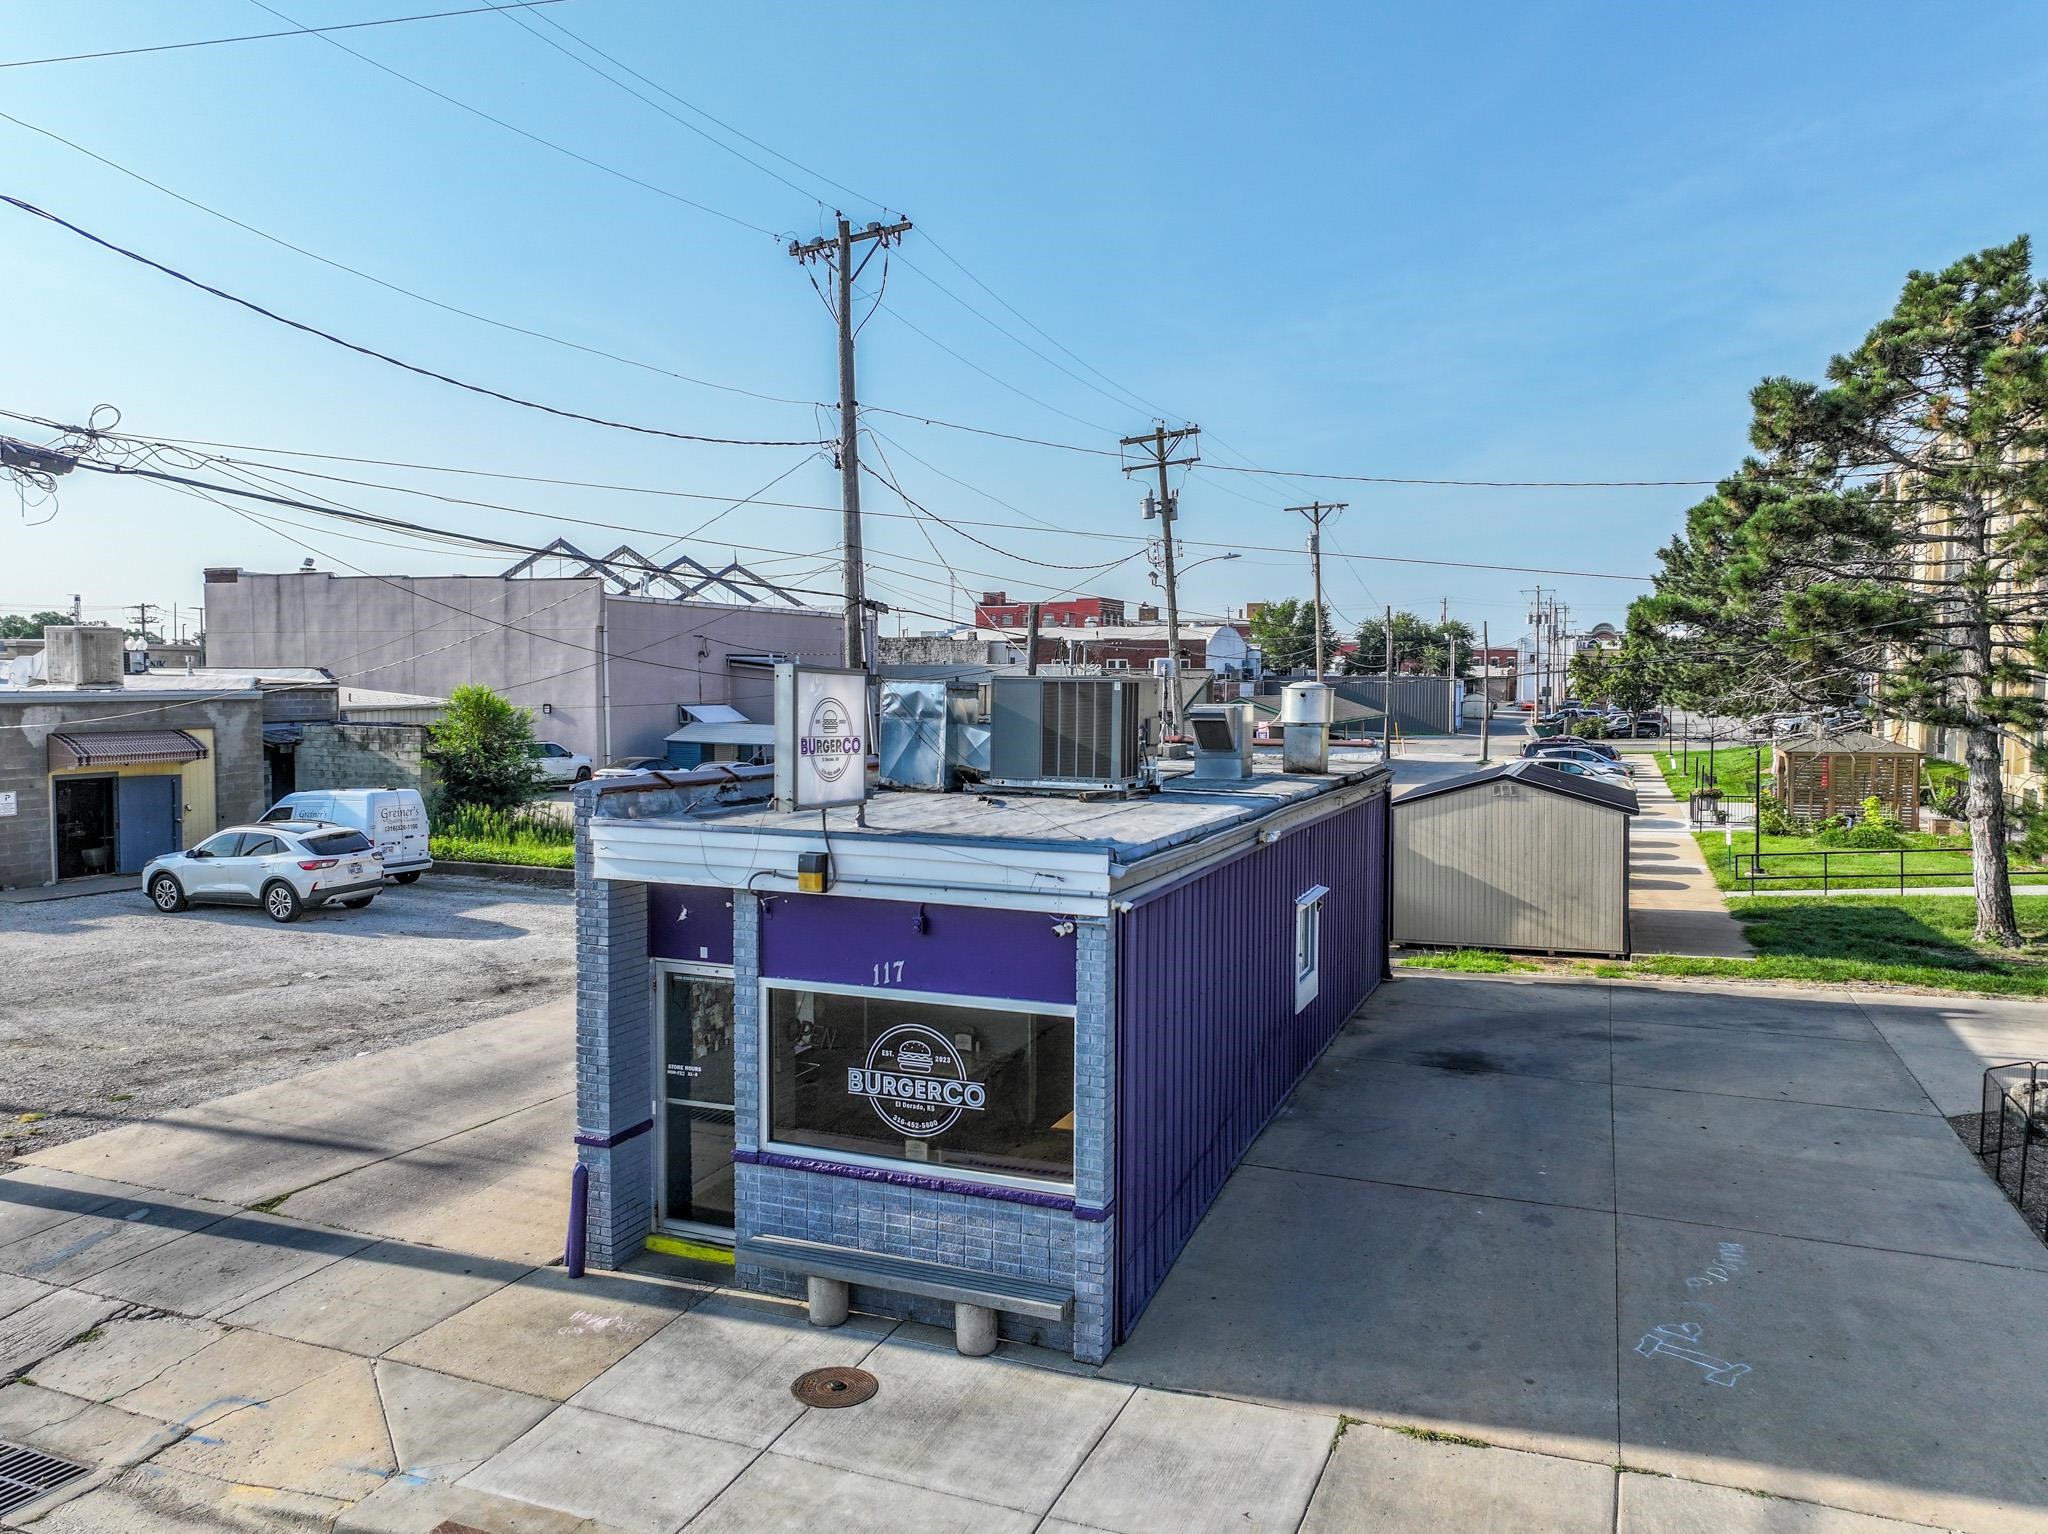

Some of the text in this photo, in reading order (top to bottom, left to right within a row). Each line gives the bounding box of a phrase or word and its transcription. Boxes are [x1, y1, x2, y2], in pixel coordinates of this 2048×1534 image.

[801, 737, 861, 755] BURGERCO
[873, 960, 905, 986] 117
[667, 1063, 684, 1071] STORE
[935, 1055, 951, 1064] 2023
[848, 1069, 986, 1107] BURGERCO
[902, 1102, 926, 1112] Dorado,
[892, 1114, 938, 1129] 316-452-5600
